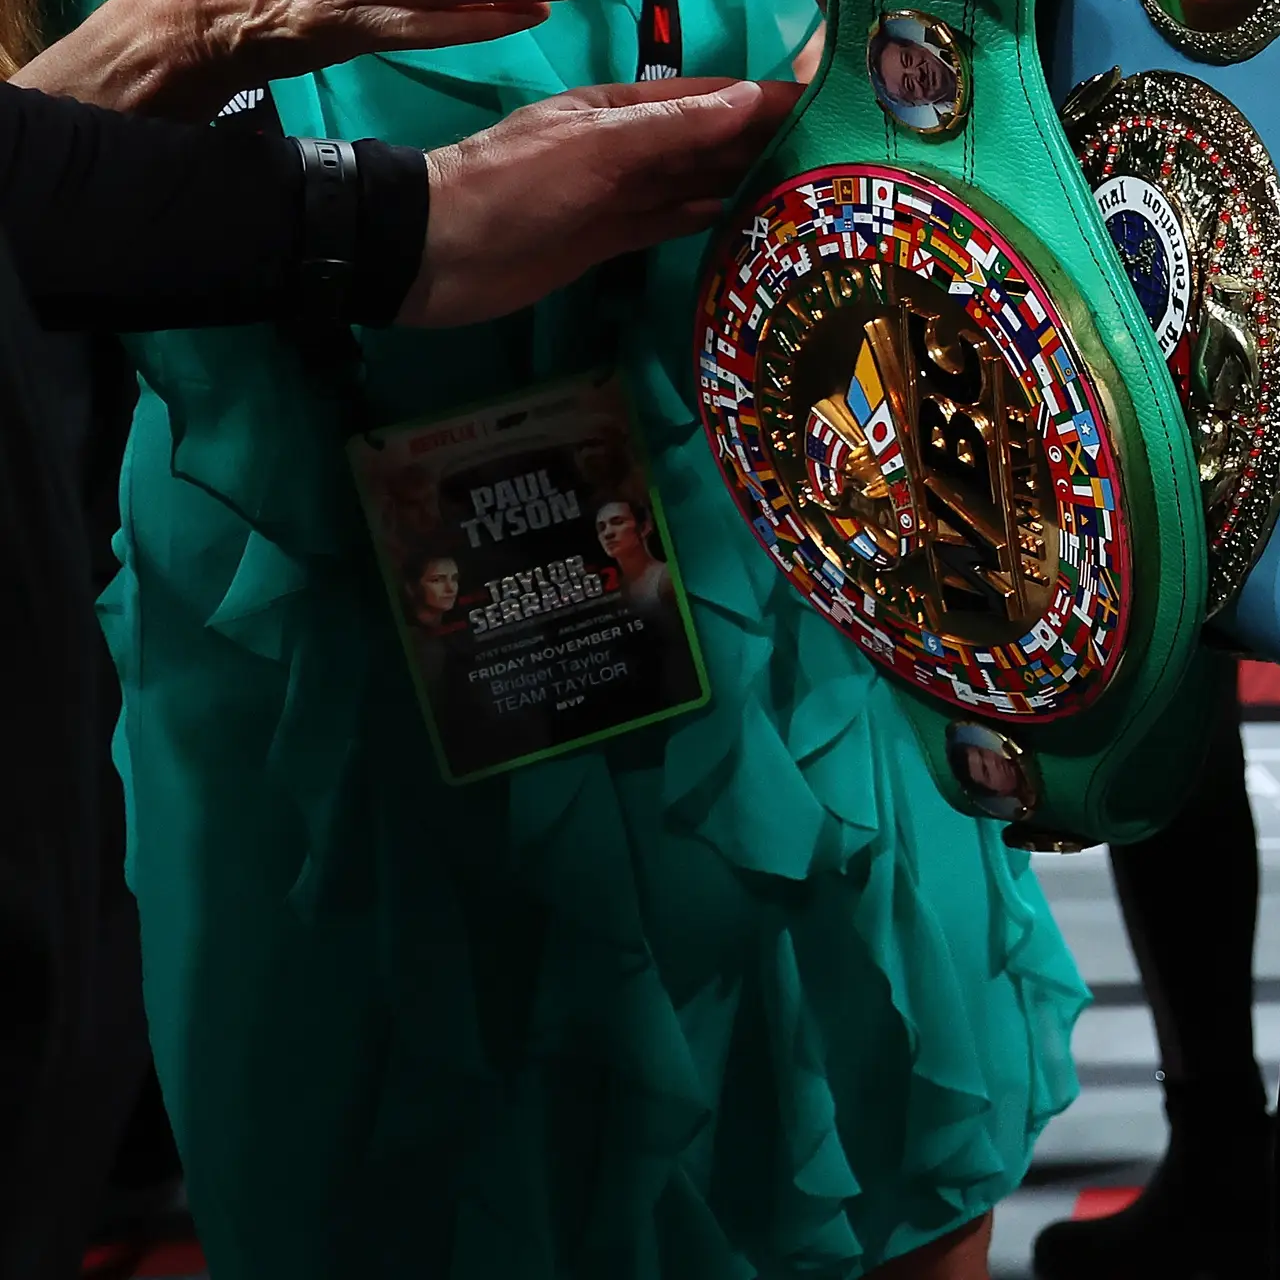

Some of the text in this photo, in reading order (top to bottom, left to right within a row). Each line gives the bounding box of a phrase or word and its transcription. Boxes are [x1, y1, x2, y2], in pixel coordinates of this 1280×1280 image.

[653, 5, 671, 44] N
[1143, 189, 1186, 322] Federation
[460, 488, 582, 549] TYSON
[470, 469, 560, 517] PAUL
[469, 573, 603, 635] SERRANO
[484, 554, 588, 603] TAYLOR
[468, 657, 527, 683] FRIDAY
[530, 624, 623, 664] NOVEMBER
[489, 648, 612, 697] Bridget Taylor
[492, 660, 629, 715] TEAM TAYLOR
